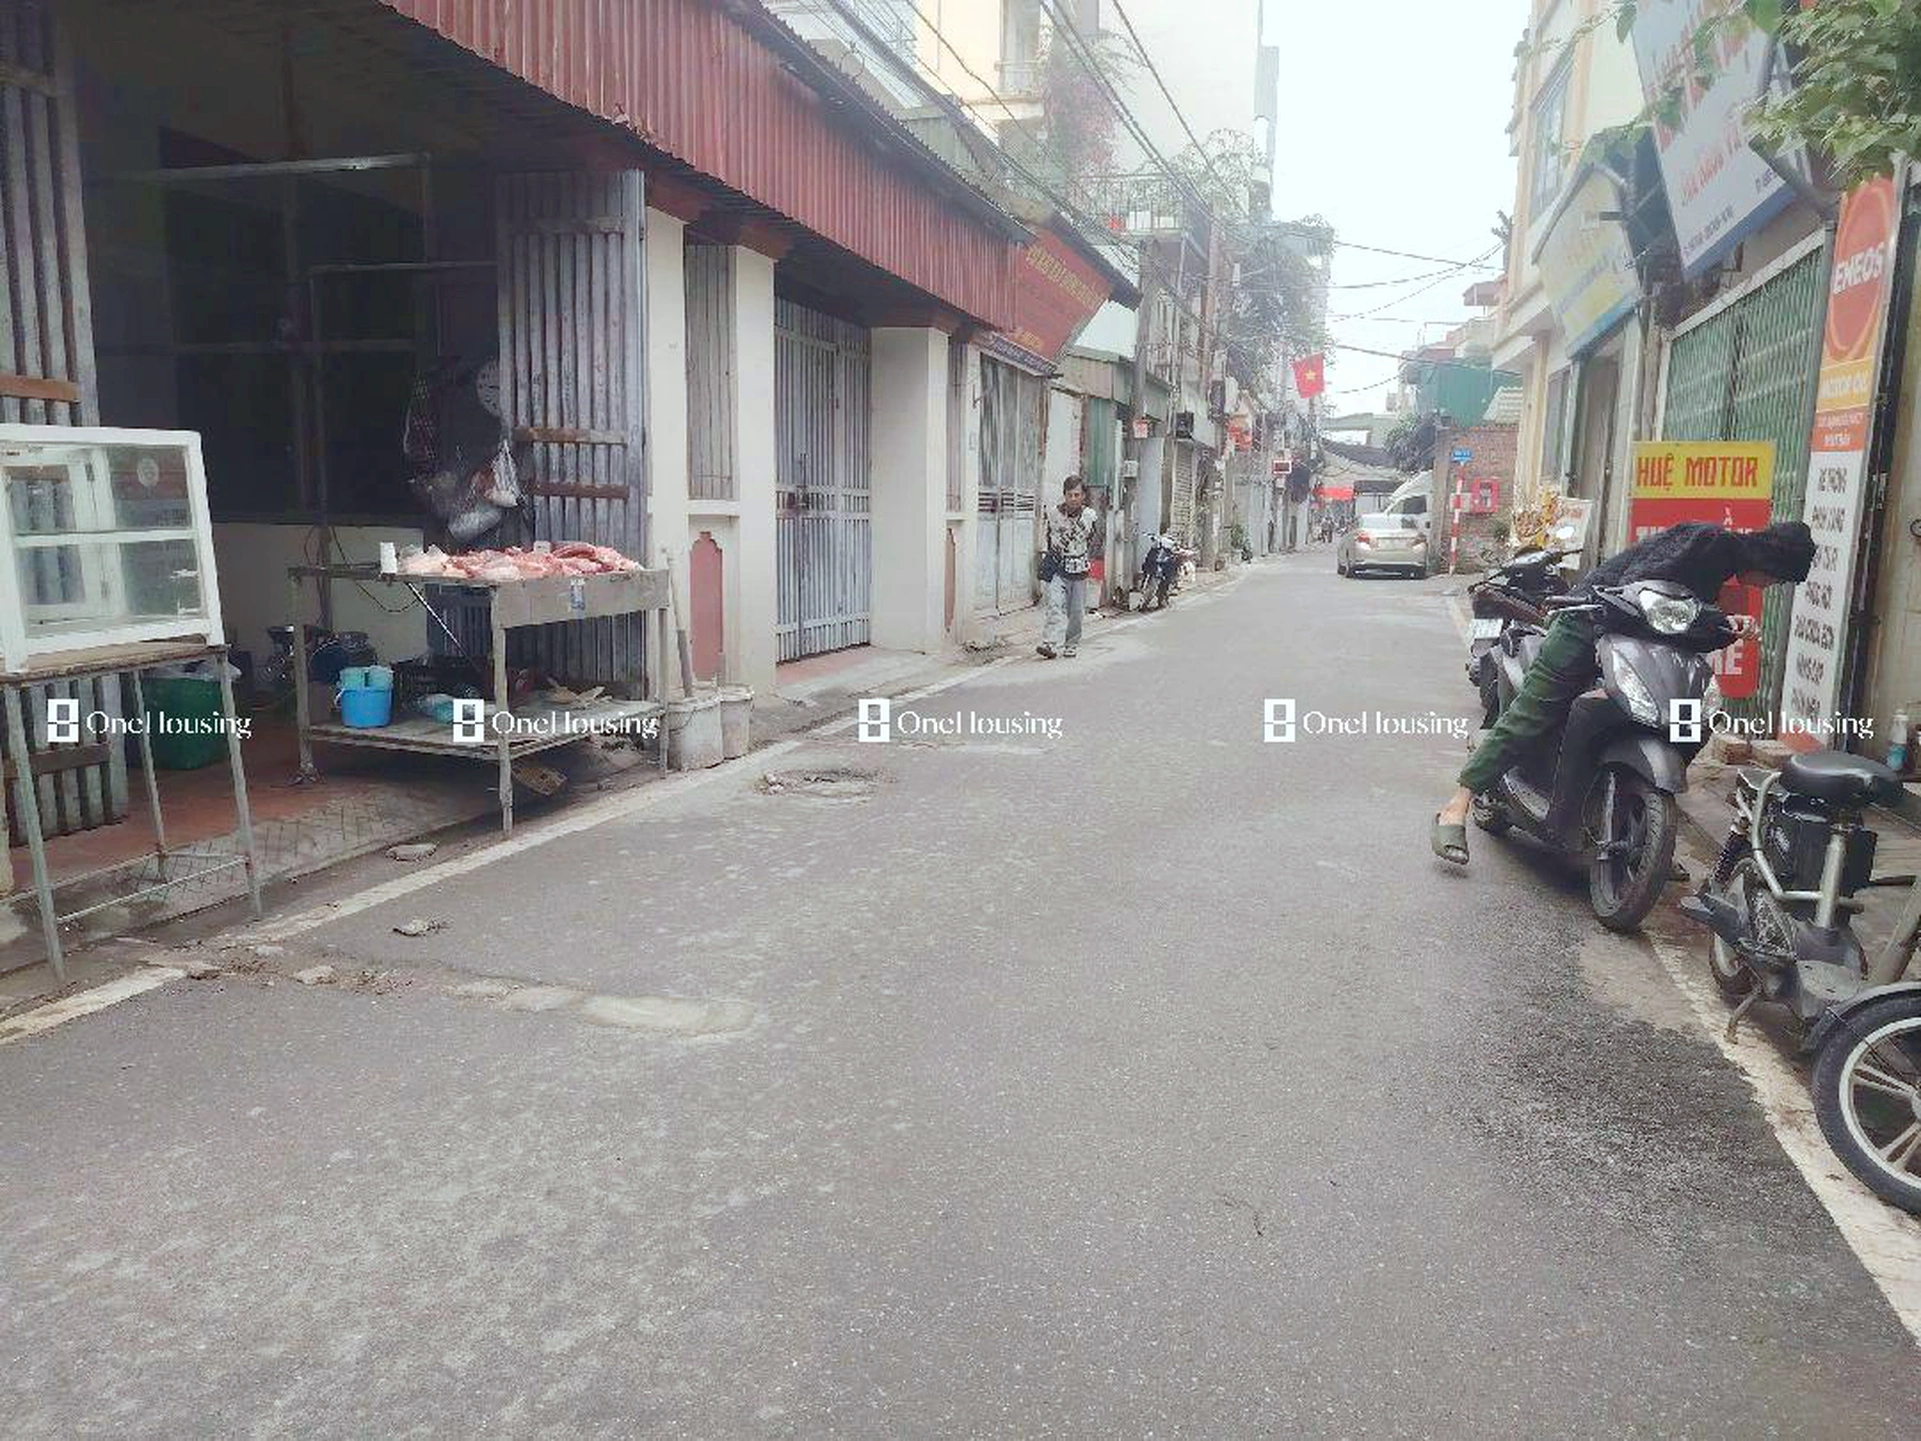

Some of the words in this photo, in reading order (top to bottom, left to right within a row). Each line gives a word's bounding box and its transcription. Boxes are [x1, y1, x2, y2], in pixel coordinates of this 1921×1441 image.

[1834, 241, 1885, 294] ENEOS
[1636, 453, 1674, 491] HUỆ
[1684, 456, 1759, 488] MOTOR
